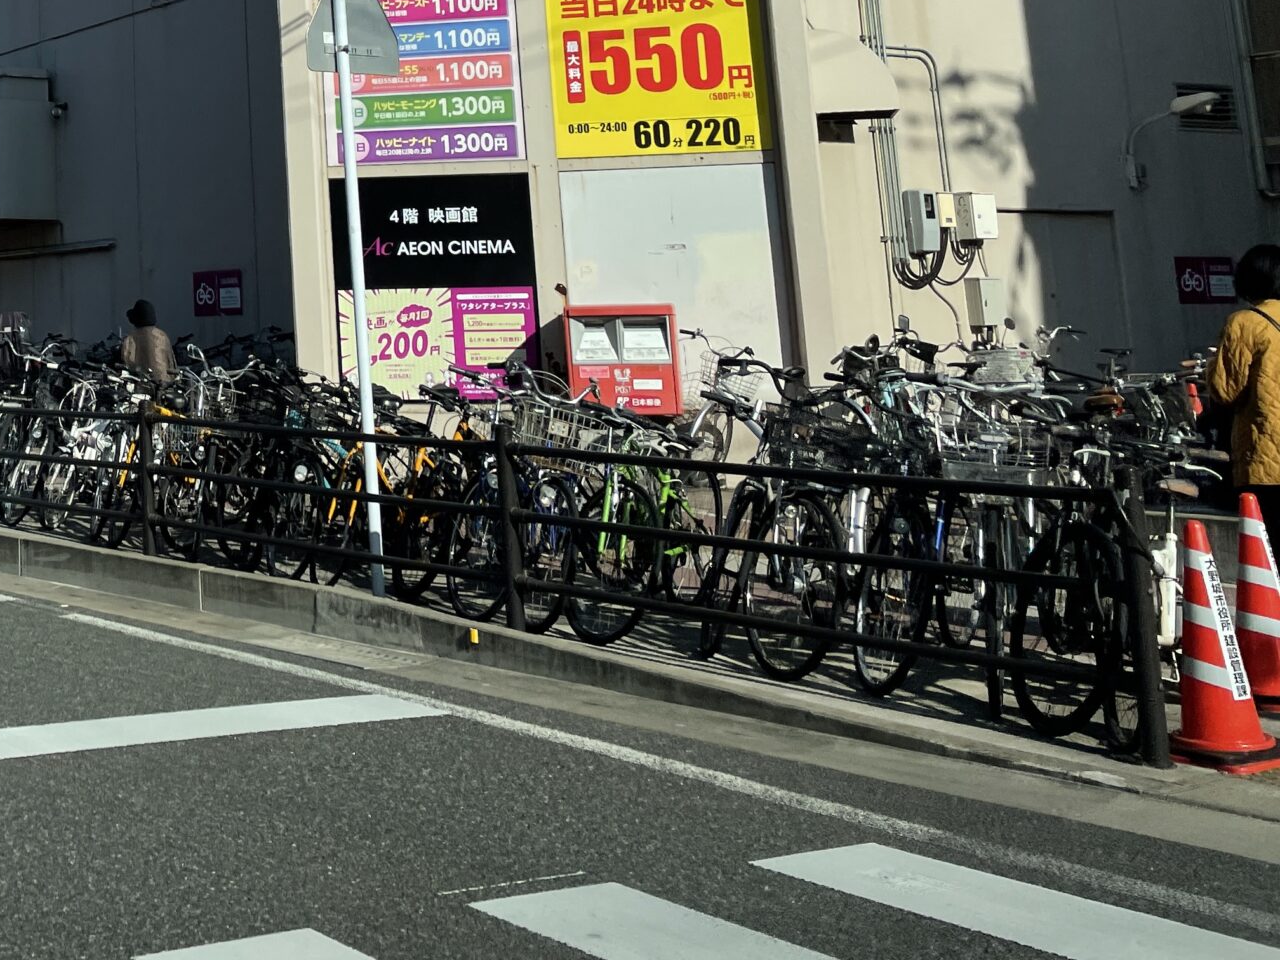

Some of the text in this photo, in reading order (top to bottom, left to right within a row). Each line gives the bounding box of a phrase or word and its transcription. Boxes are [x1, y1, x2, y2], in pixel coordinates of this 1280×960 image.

[397, 28, 501, 50] マンデー 1,100円
[566, 23, 754, 95] 最大料金 550円
[436, 60, 503, 83] 1,100円
[373, 95, 505, 117] ハッピーモーニング 1,300円
[375, 132, 508, 155] ハッピーナイト 1,300円
[389, 206, 479, 224] 4階 映画館
[397, 240, 444, 256] AEON
[447, 239, 516, 256] CINEMA
[399, 309, 430, 324] 毎月1回
[370, 329, 441, 367] ,200円
[1205, 557, 1232, 632] 大野城市役所
